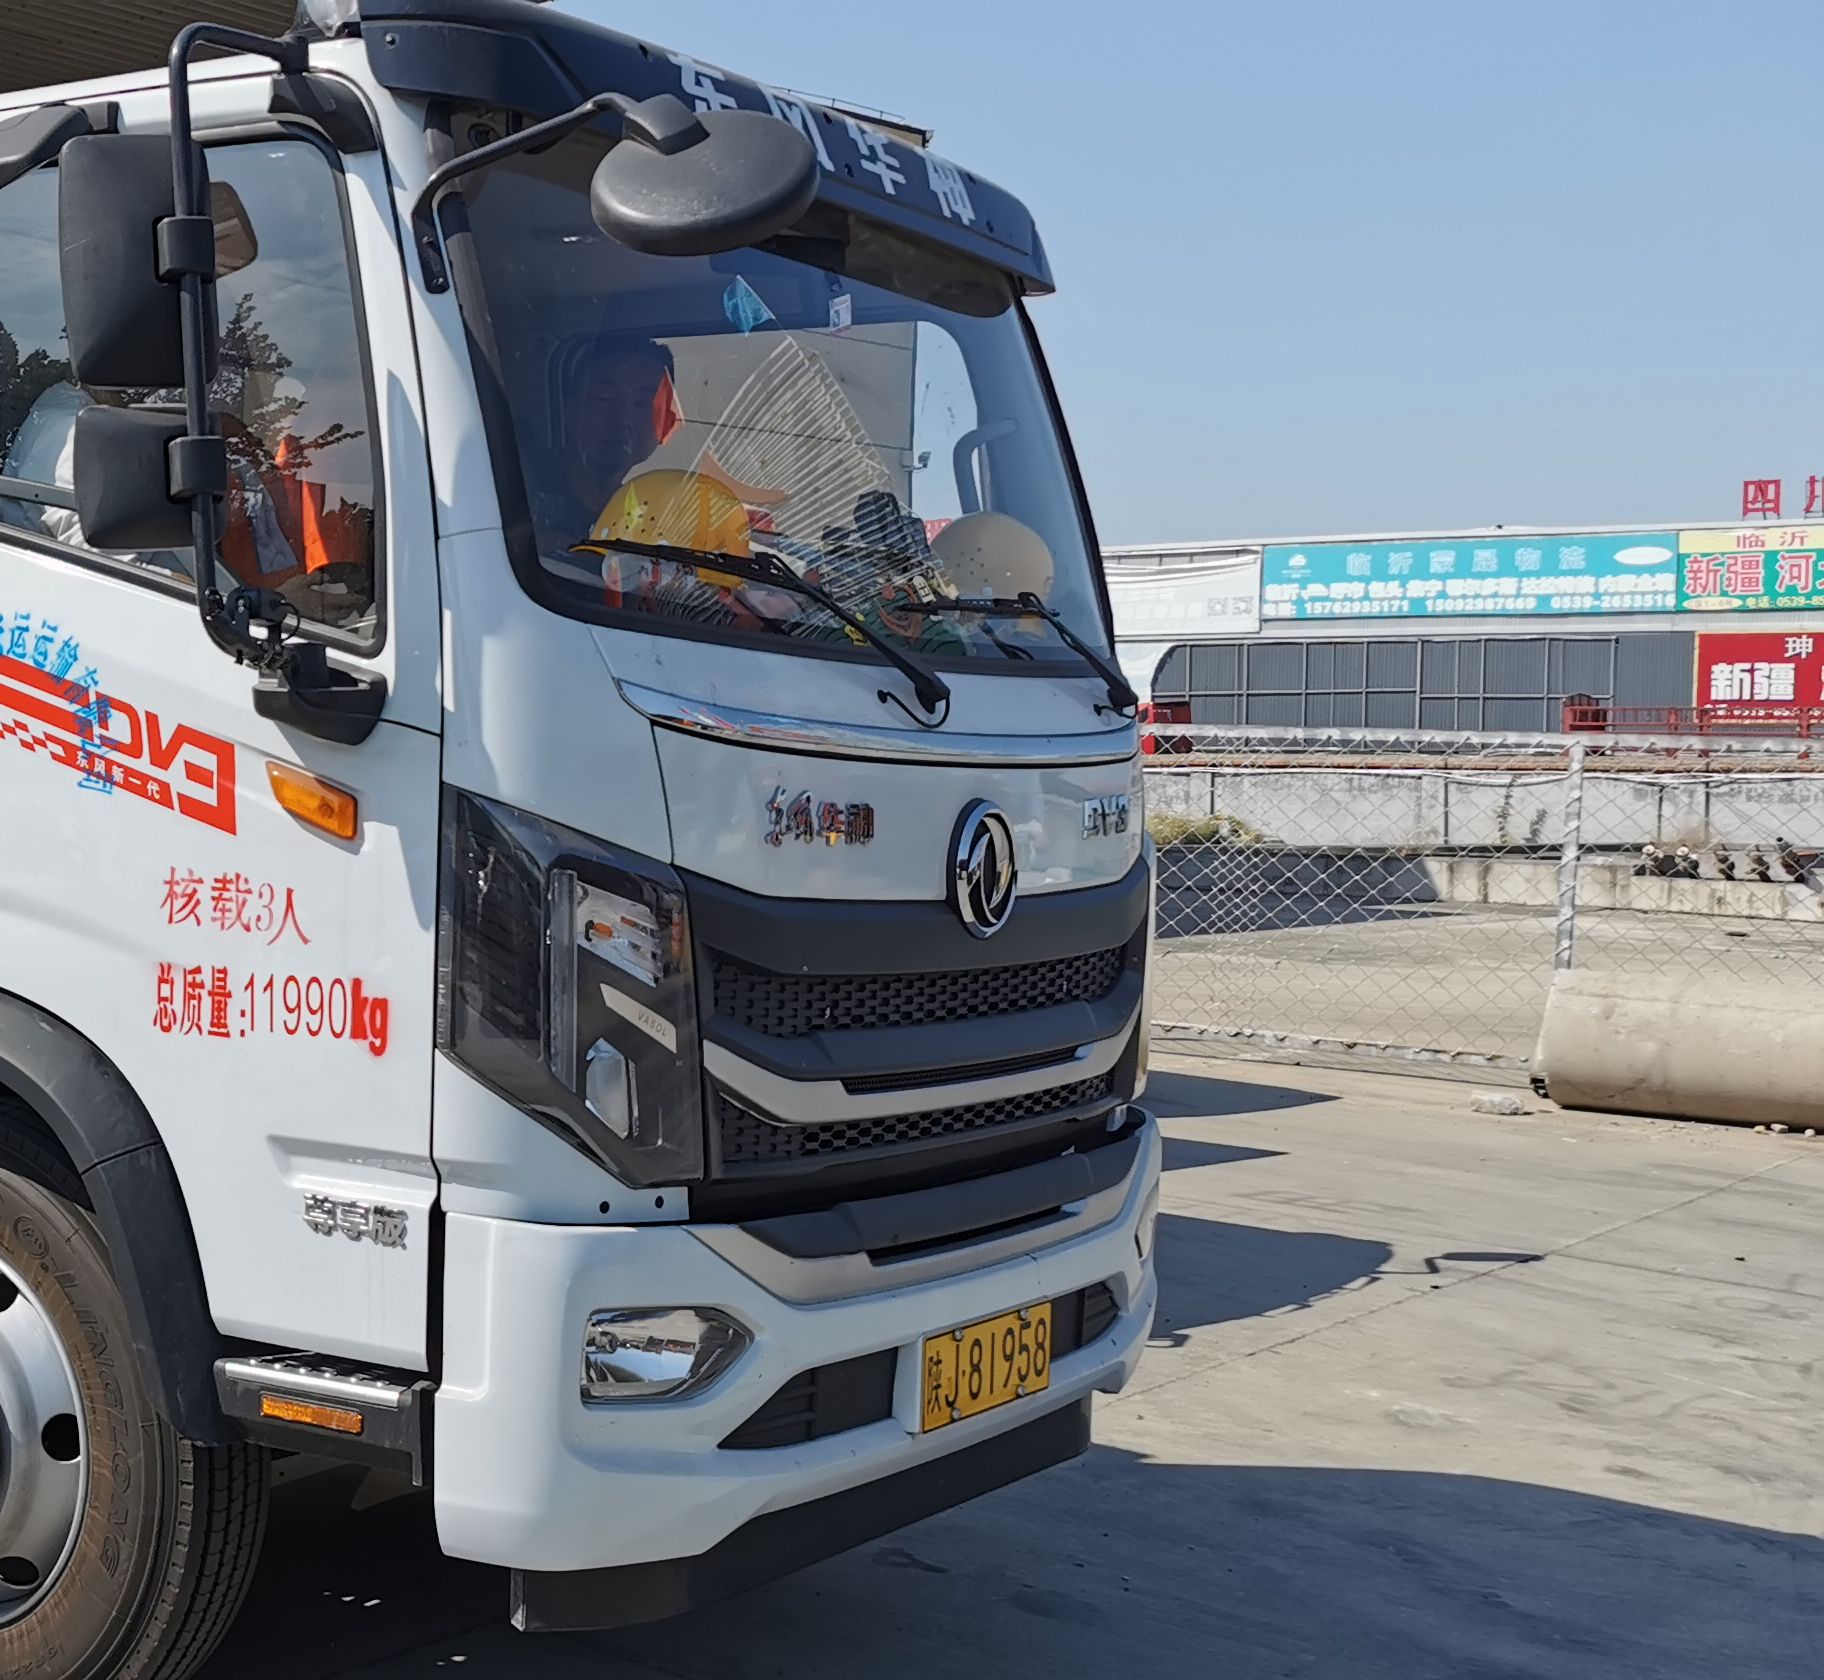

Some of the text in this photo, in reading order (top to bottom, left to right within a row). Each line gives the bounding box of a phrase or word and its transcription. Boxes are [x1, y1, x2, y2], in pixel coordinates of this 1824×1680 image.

[1737, 529, 1810, 549] 临沂
[1775, 553, 1824, 595] 河
[1710, 662, 1796, 701] 新疆
[75, 751, 161, 799] 东风新一代
[160, 866, 312, 946] 核载3人
[302, 1192, 409, 1251] 尊享版
